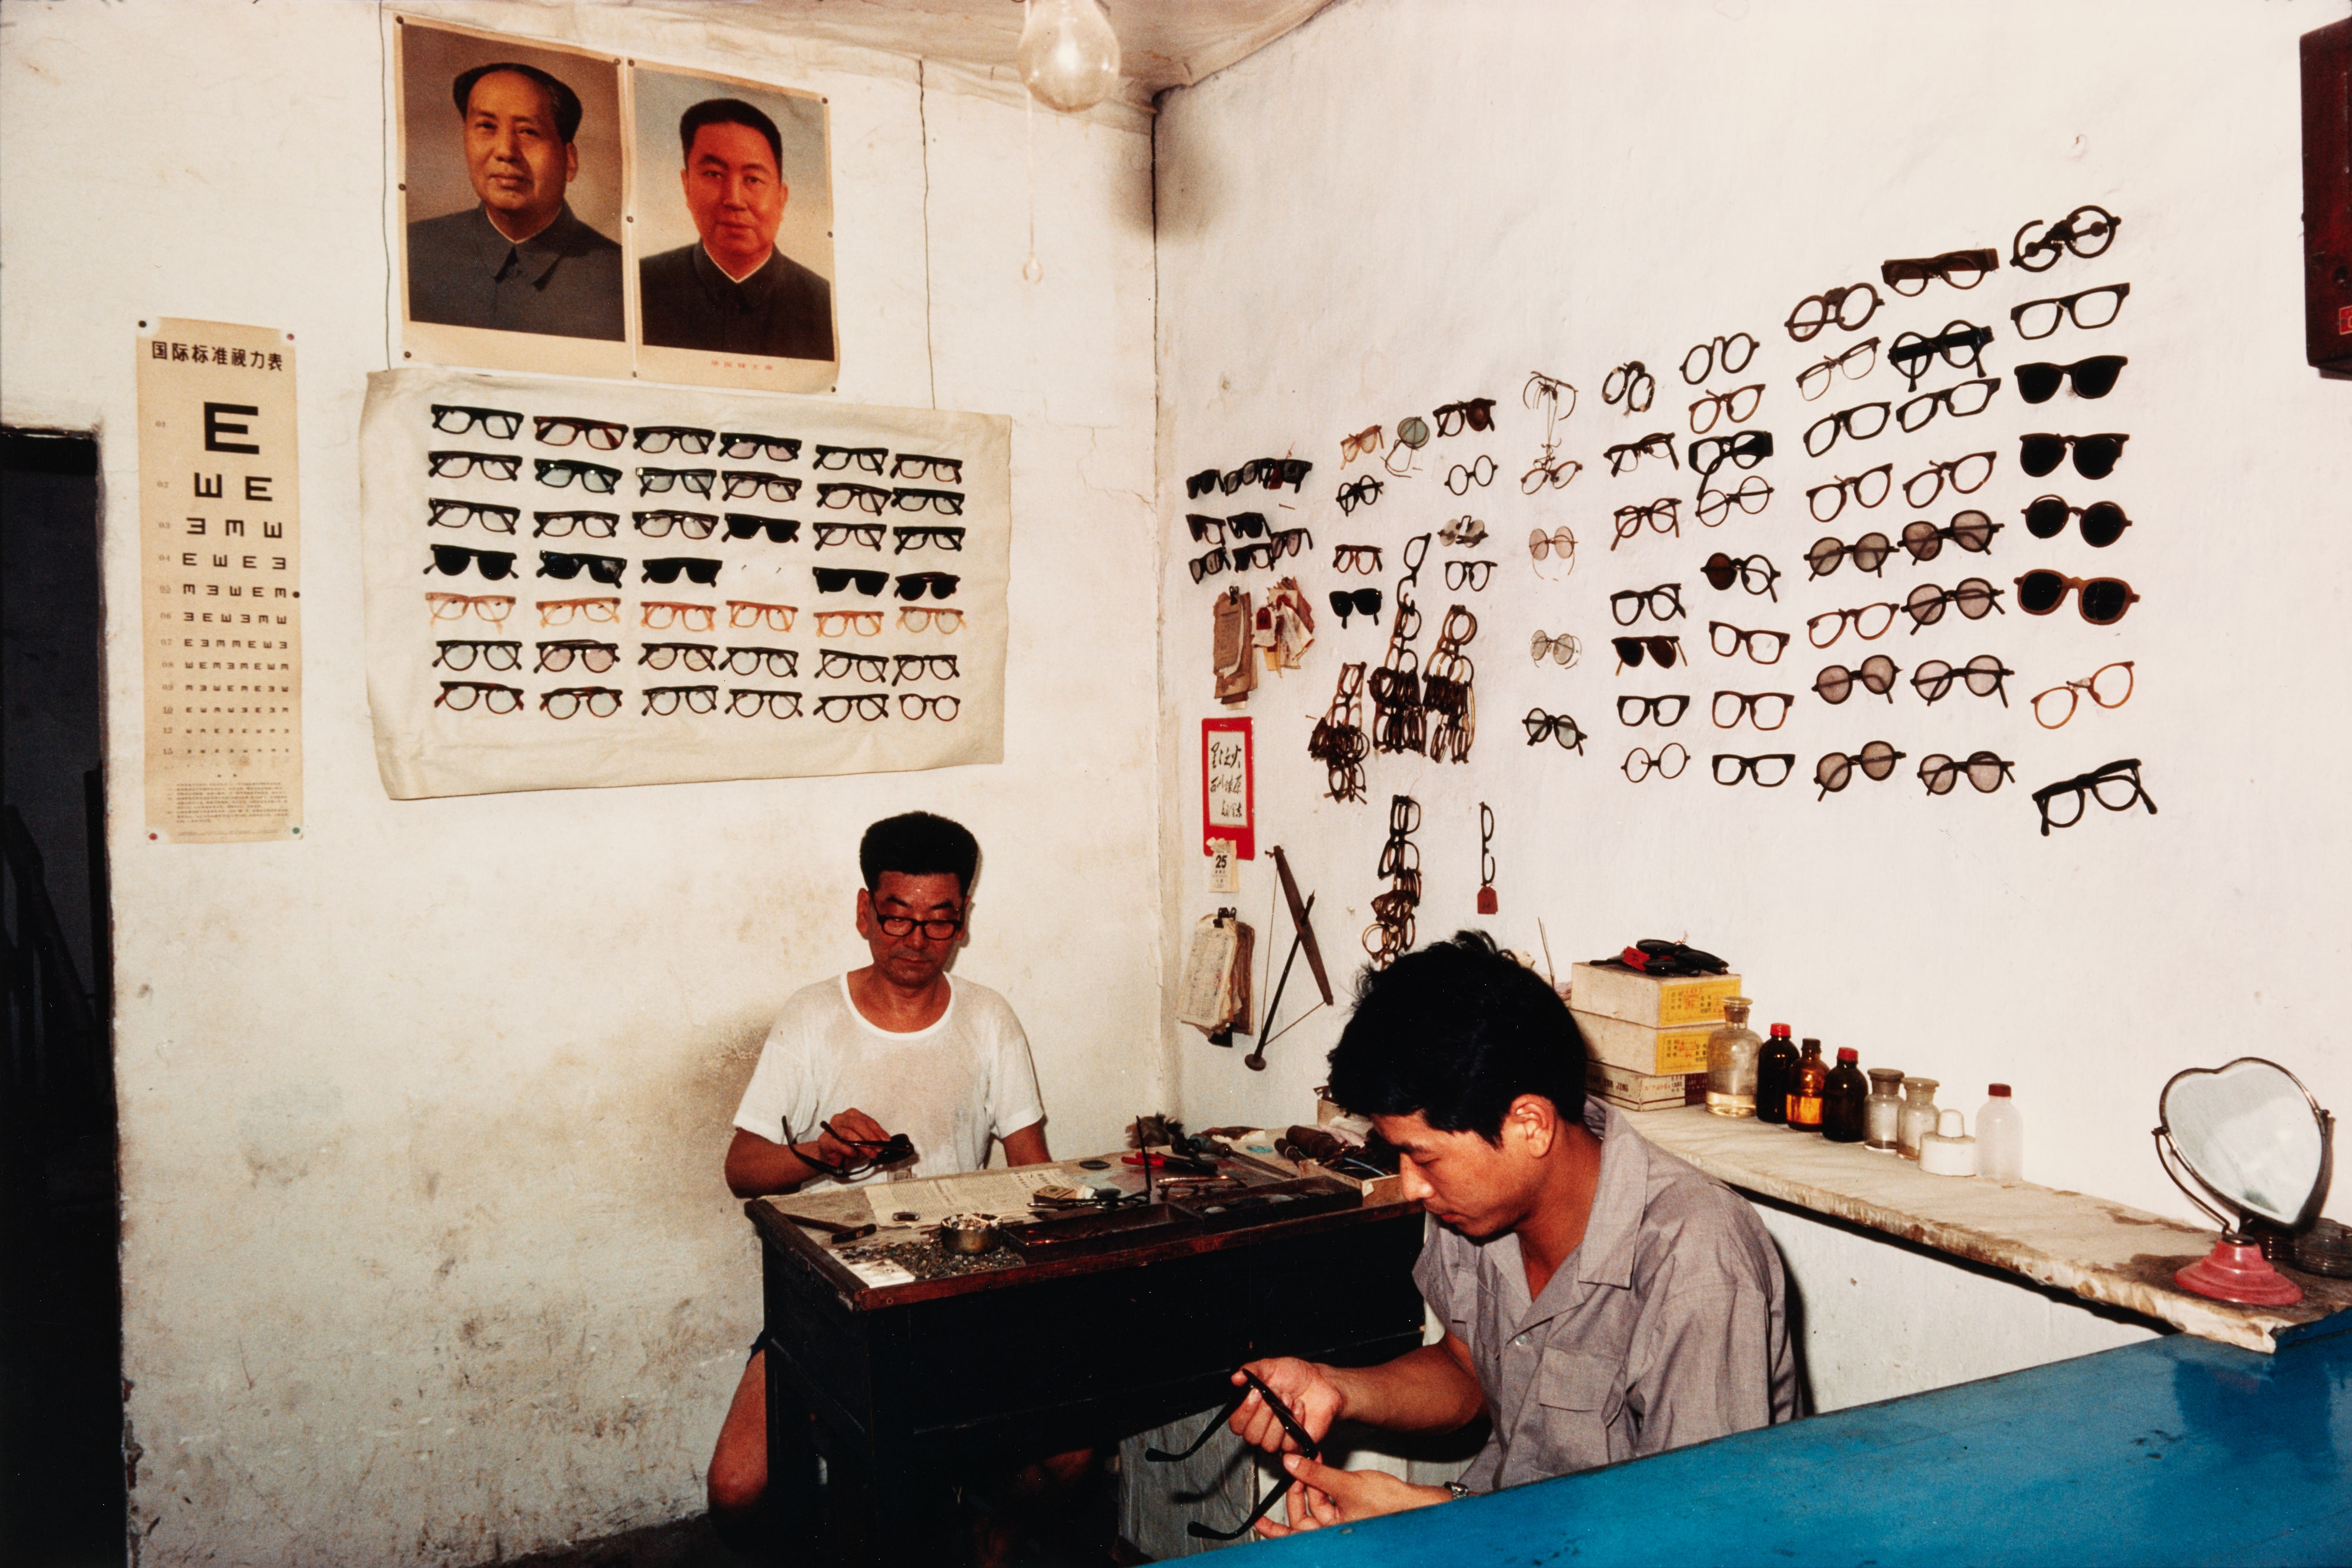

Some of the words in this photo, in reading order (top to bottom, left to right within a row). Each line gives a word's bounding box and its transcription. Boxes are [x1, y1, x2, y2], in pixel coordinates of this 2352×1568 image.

[152, 340, 283, 372] 国际标准视力表
[203, 402, 260, 455] E
[245, 476, 273, 502] E
[1215, 854, 1228, 869] 25
